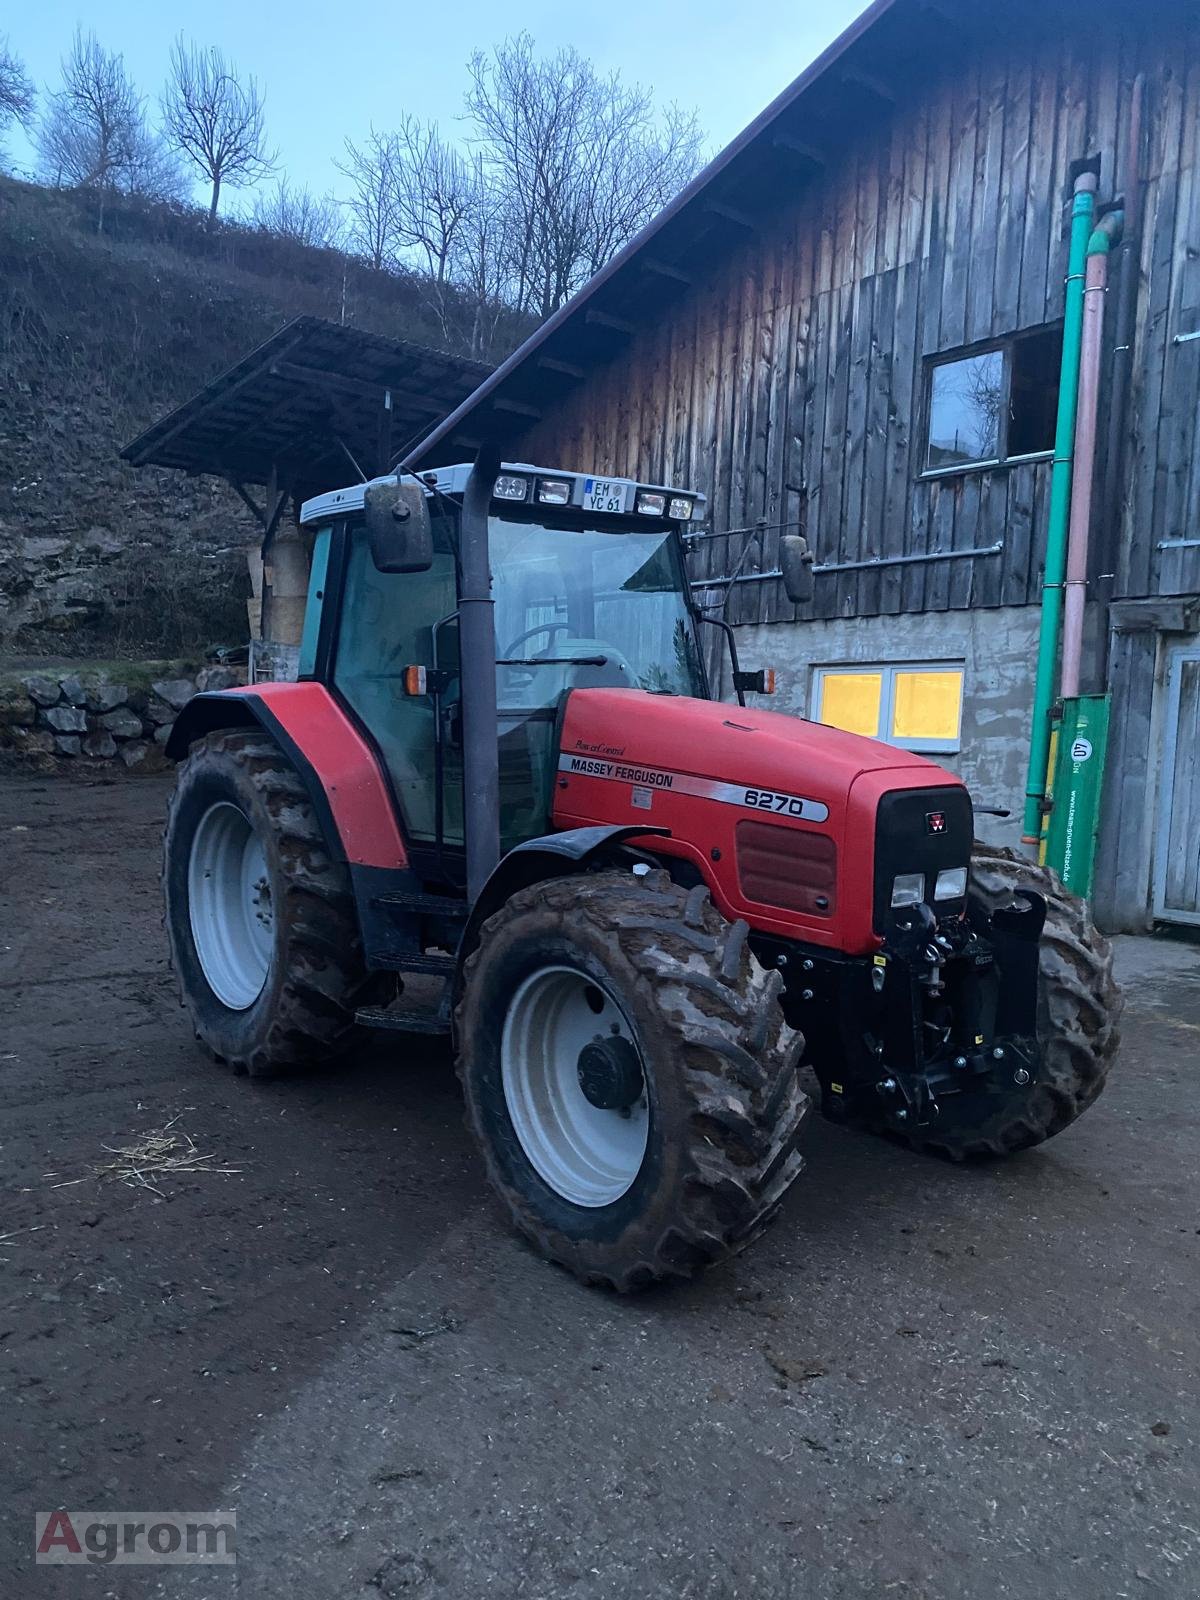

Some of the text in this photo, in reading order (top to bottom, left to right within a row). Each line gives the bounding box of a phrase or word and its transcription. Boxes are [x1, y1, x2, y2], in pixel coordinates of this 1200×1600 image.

[595, 483, 610, 496] EM
[591, 496, 620, 511] YC 61
[1073, 743, 1087, 757] 40
[571, 758, 673, 788] MASSEY FERGUSON
[744, 790, 803, 816] 6270
